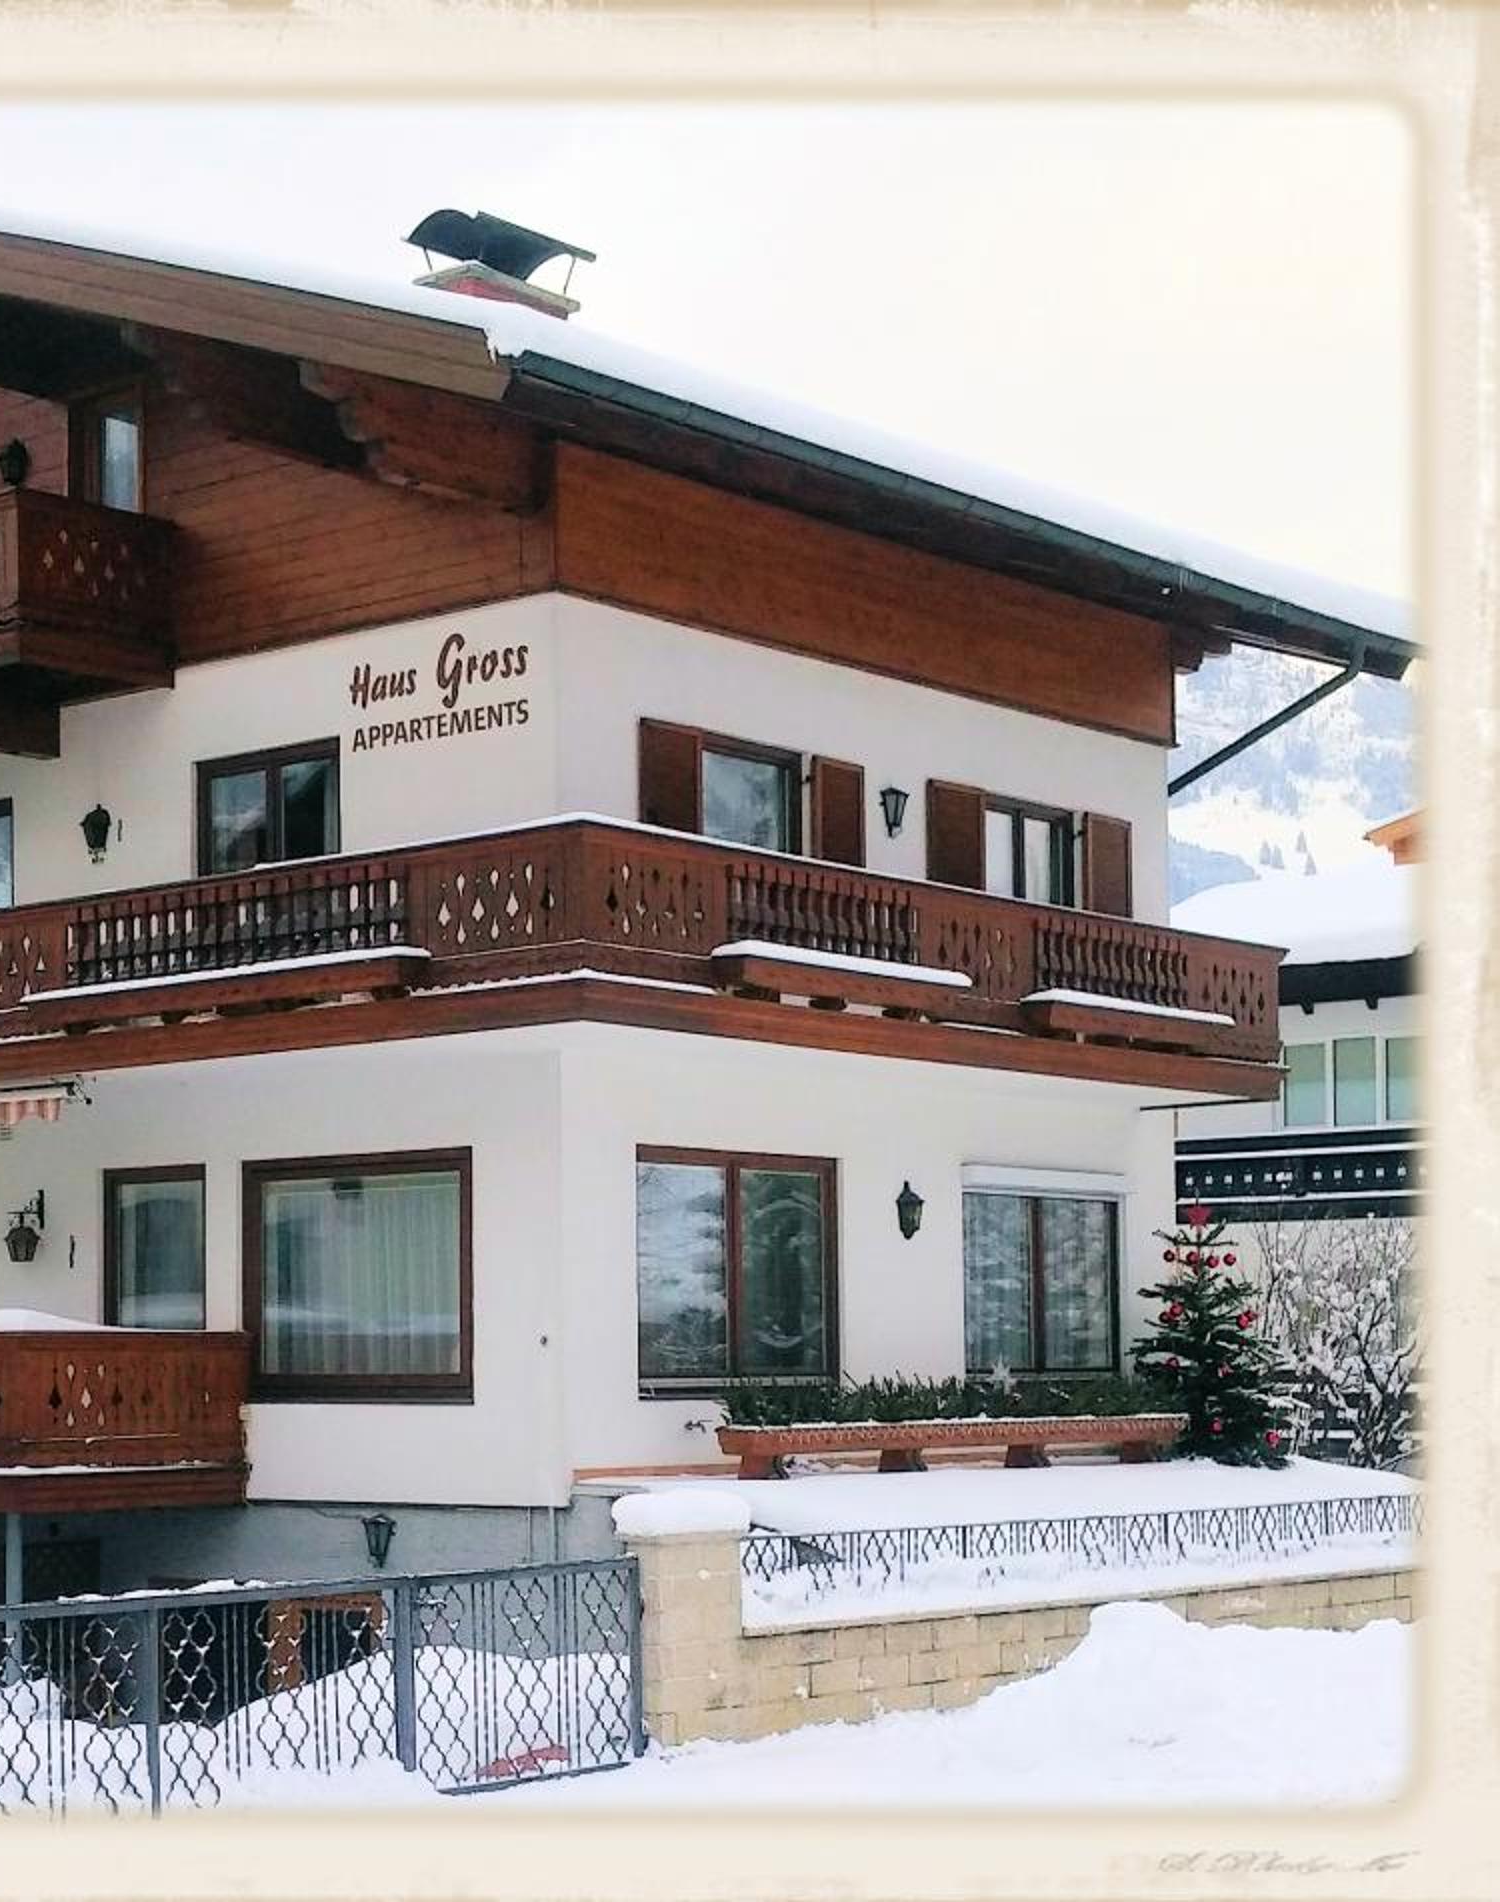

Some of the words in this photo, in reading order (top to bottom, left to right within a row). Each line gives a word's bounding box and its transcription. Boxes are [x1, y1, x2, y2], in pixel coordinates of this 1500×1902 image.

[349, 663, 417, 709] Haus
[436, 633, 529, 709] Gross
[352, 699, 529, 753] APPARTEMENTS
